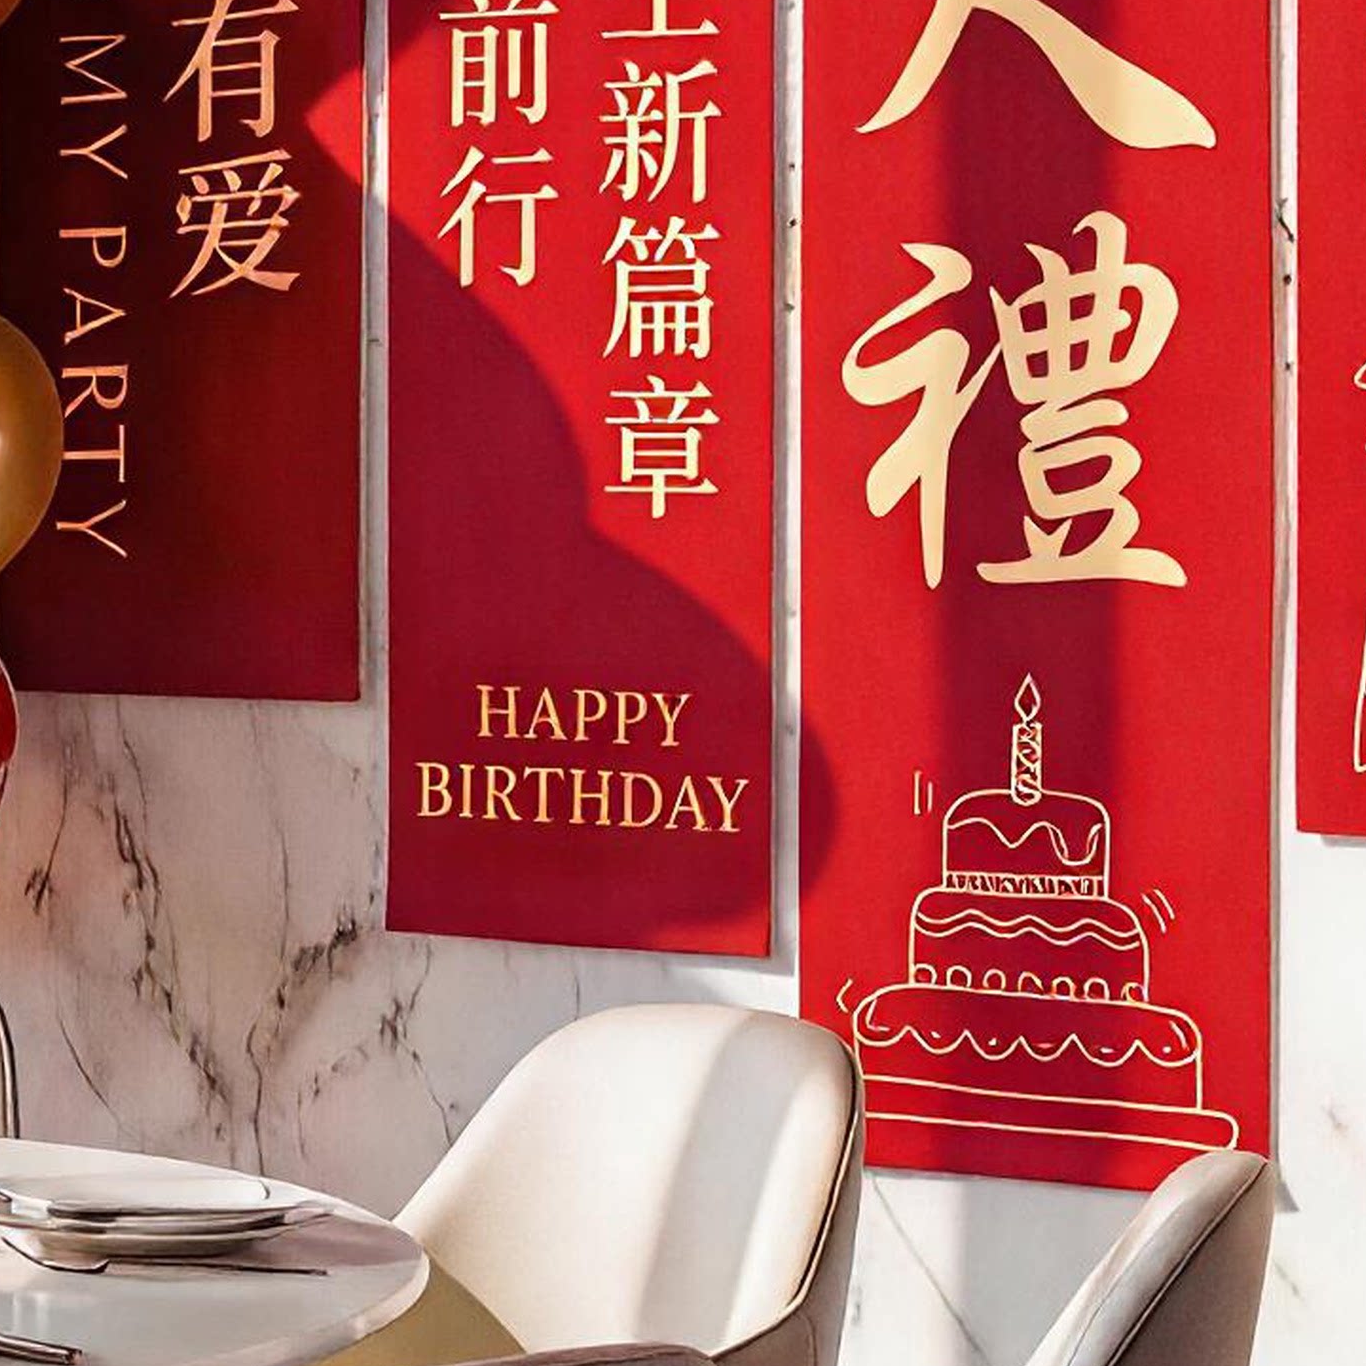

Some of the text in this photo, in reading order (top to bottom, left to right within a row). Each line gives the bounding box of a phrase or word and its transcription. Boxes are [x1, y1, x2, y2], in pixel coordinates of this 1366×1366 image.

[60, 34, 128, 179] MY
[56, 226, 129, 557] PARTY
[476, 684, 691, 747] HAPPY
[414, 761, 749, 833] BIRTHDAY
